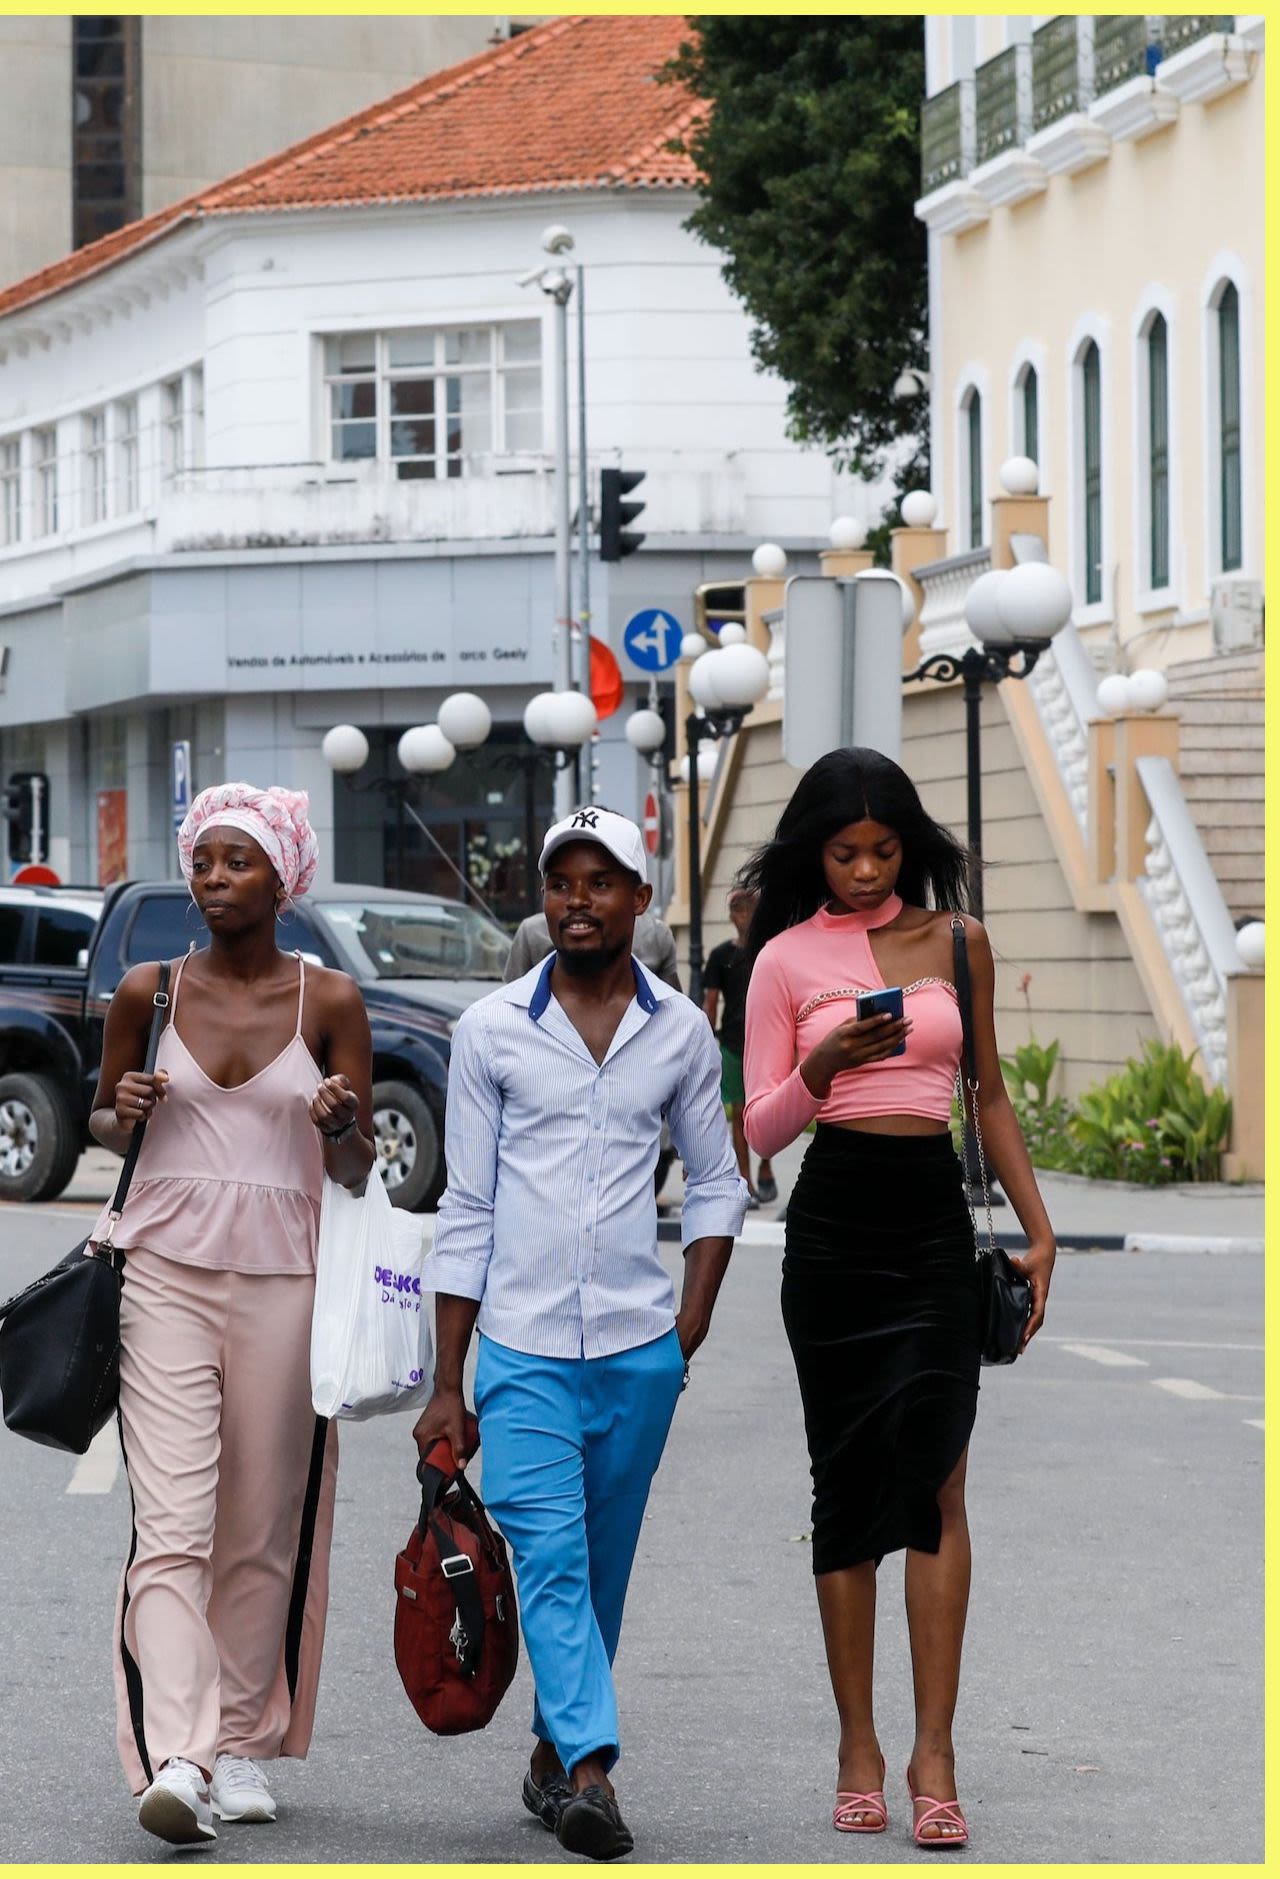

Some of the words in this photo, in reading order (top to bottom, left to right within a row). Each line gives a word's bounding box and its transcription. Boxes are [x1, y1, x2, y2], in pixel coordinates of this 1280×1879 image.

[227, 655, 269, 667] Vendas
[272, 654, 286, 666] de
[357, 653, 365, 663] e
[431, 650, 446, 661] de
[493, 647, 528, 661] Geely
[175, 748, 186, 802] P
